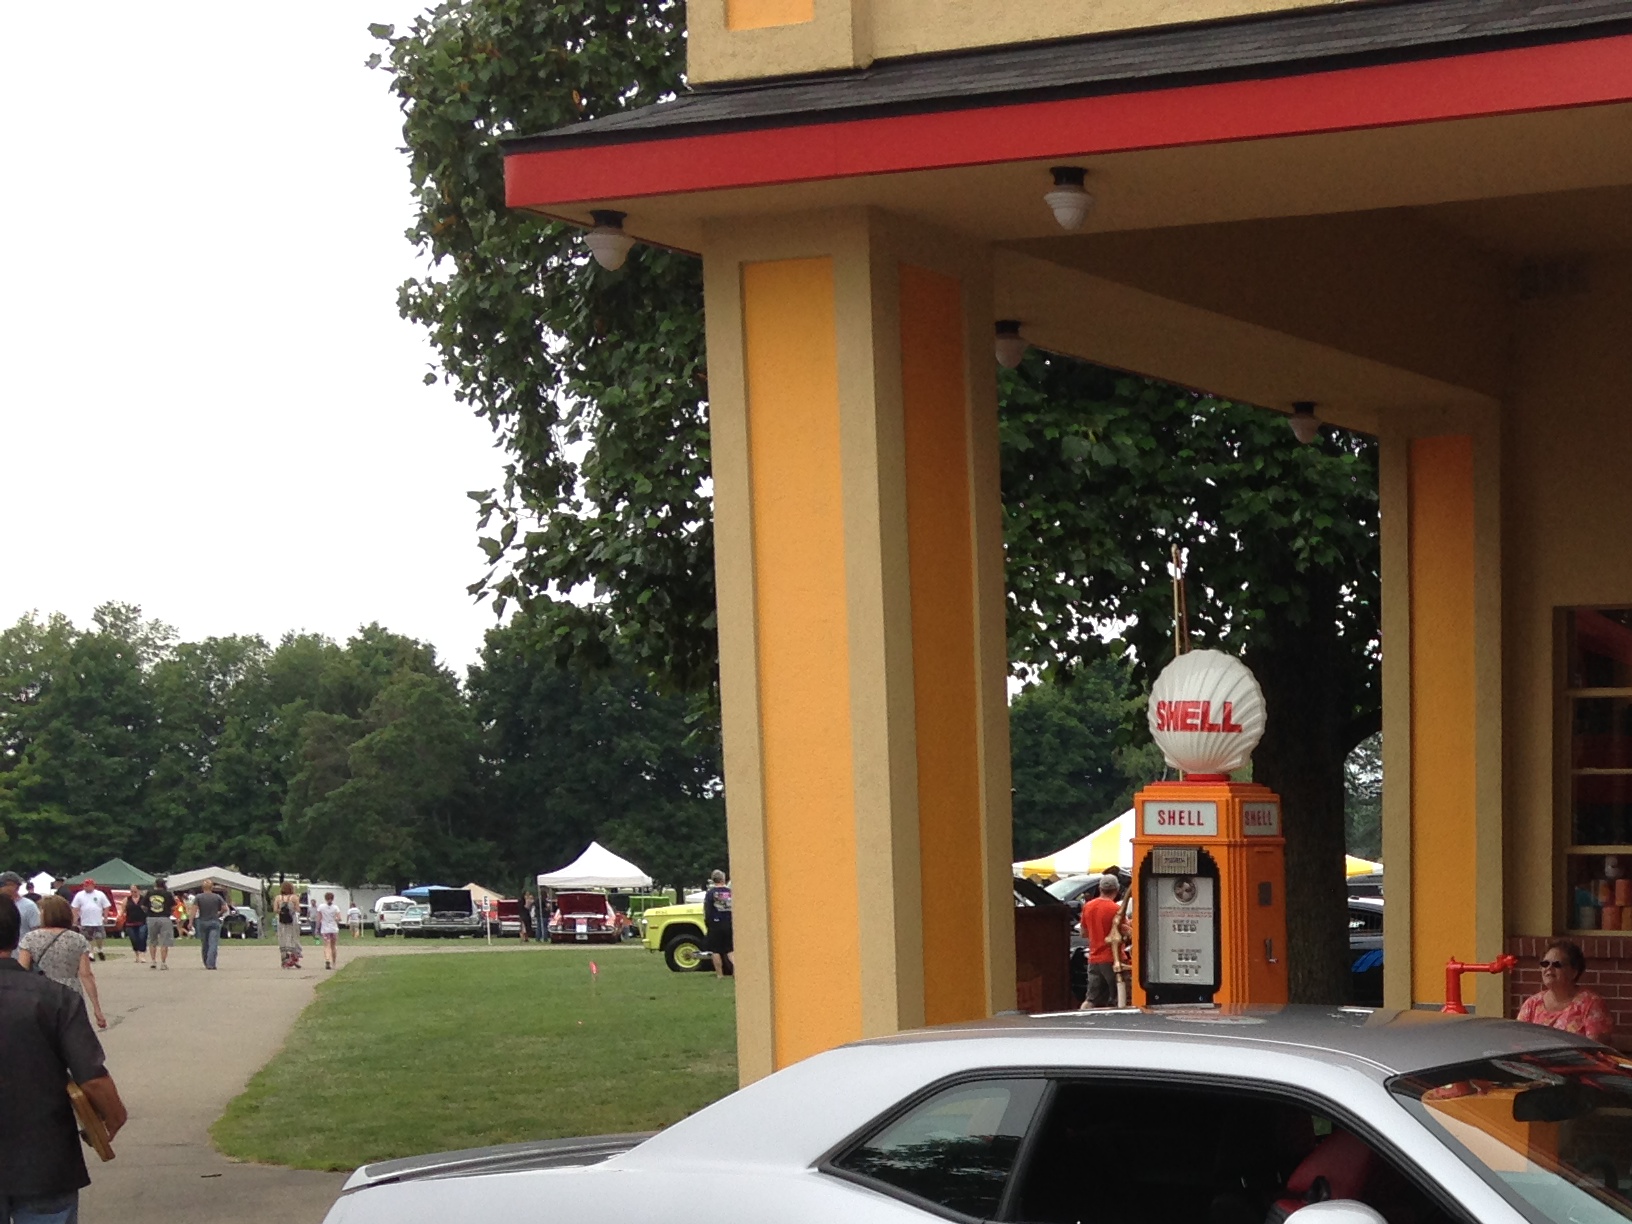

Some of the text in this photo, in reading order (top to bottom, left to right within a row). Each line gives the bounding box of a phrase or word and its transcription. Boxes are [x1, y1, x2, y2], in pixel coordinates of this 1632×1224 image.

[1156, 700, 1243, 733] SHELL
[1157, 810, 1205, 827] SHELL
[1244, 809, 1273, 827] SHELL
